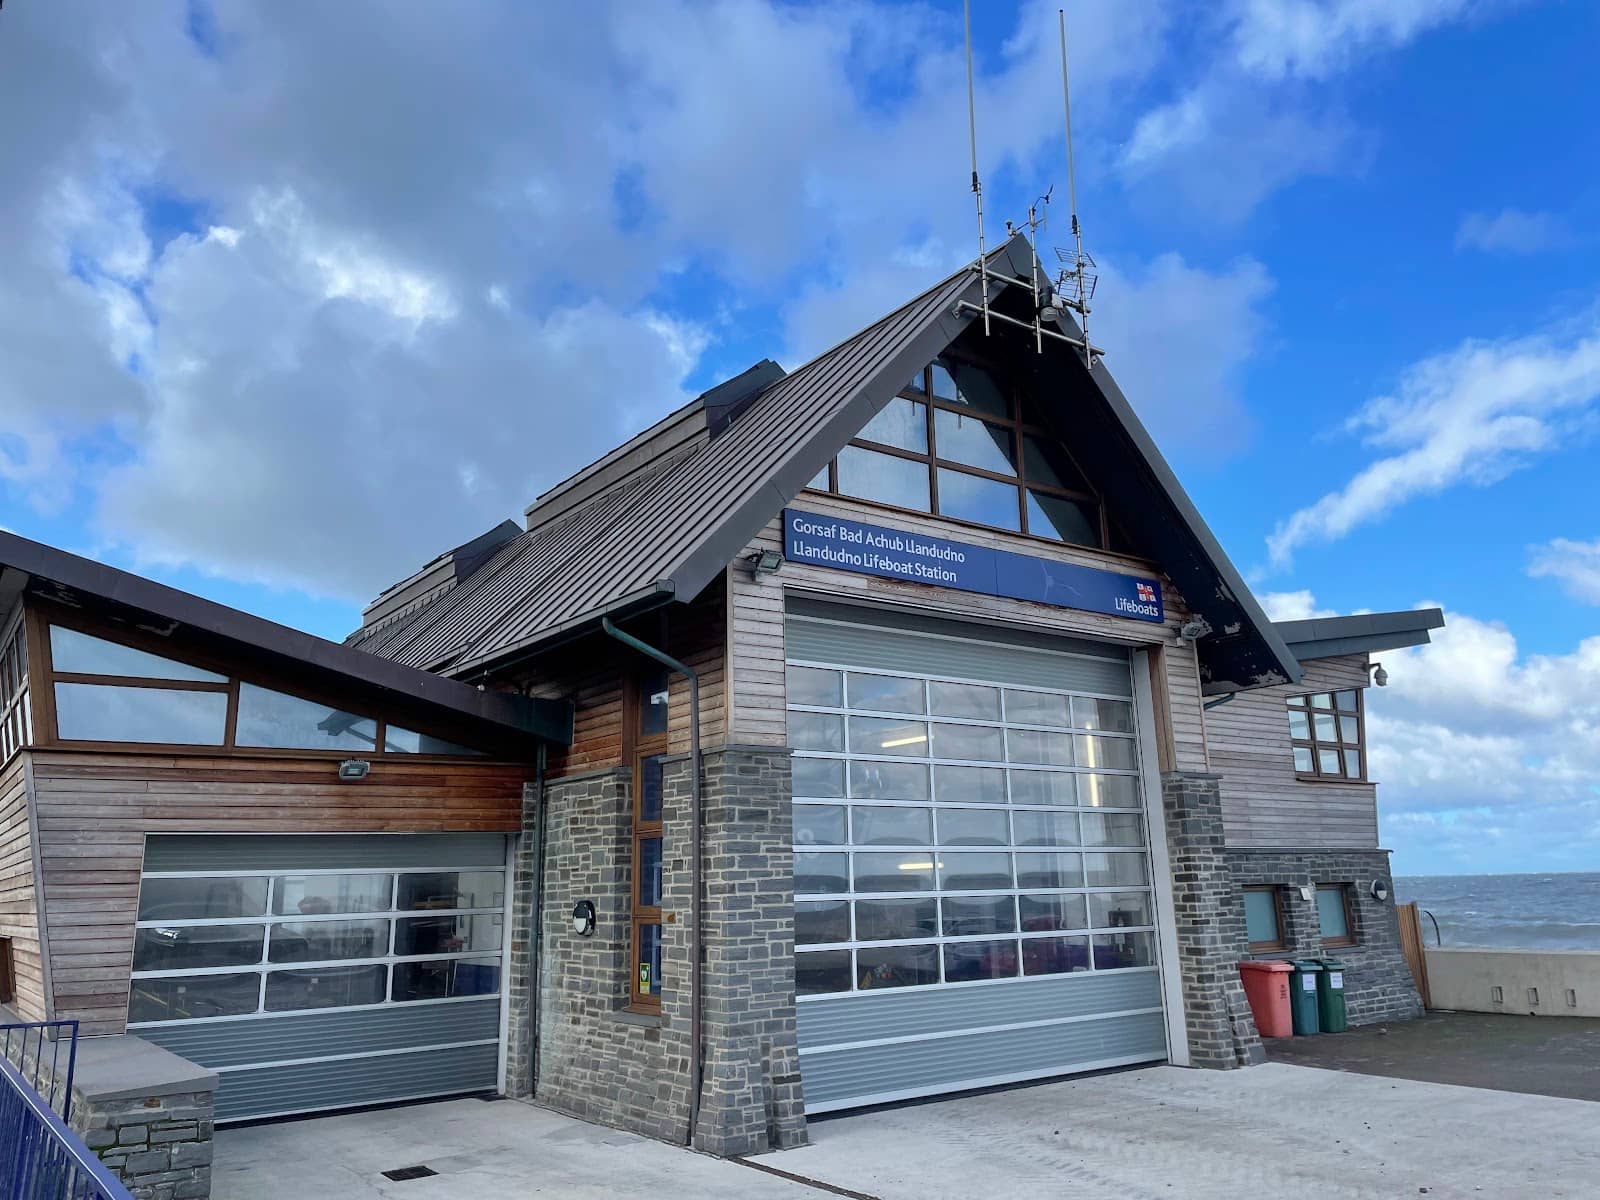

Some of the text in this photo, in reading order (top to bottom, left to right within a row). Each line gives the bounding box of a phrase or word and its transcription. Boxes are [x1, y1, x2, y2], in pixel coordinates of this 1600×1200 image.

[793, 518, 965, 563] Gorsaf Bad Achub Llandudno
[794, 541, 957, 582] Llandudno Lifeboat Station
[1115, 597, 1158, 616] Lifeboats
